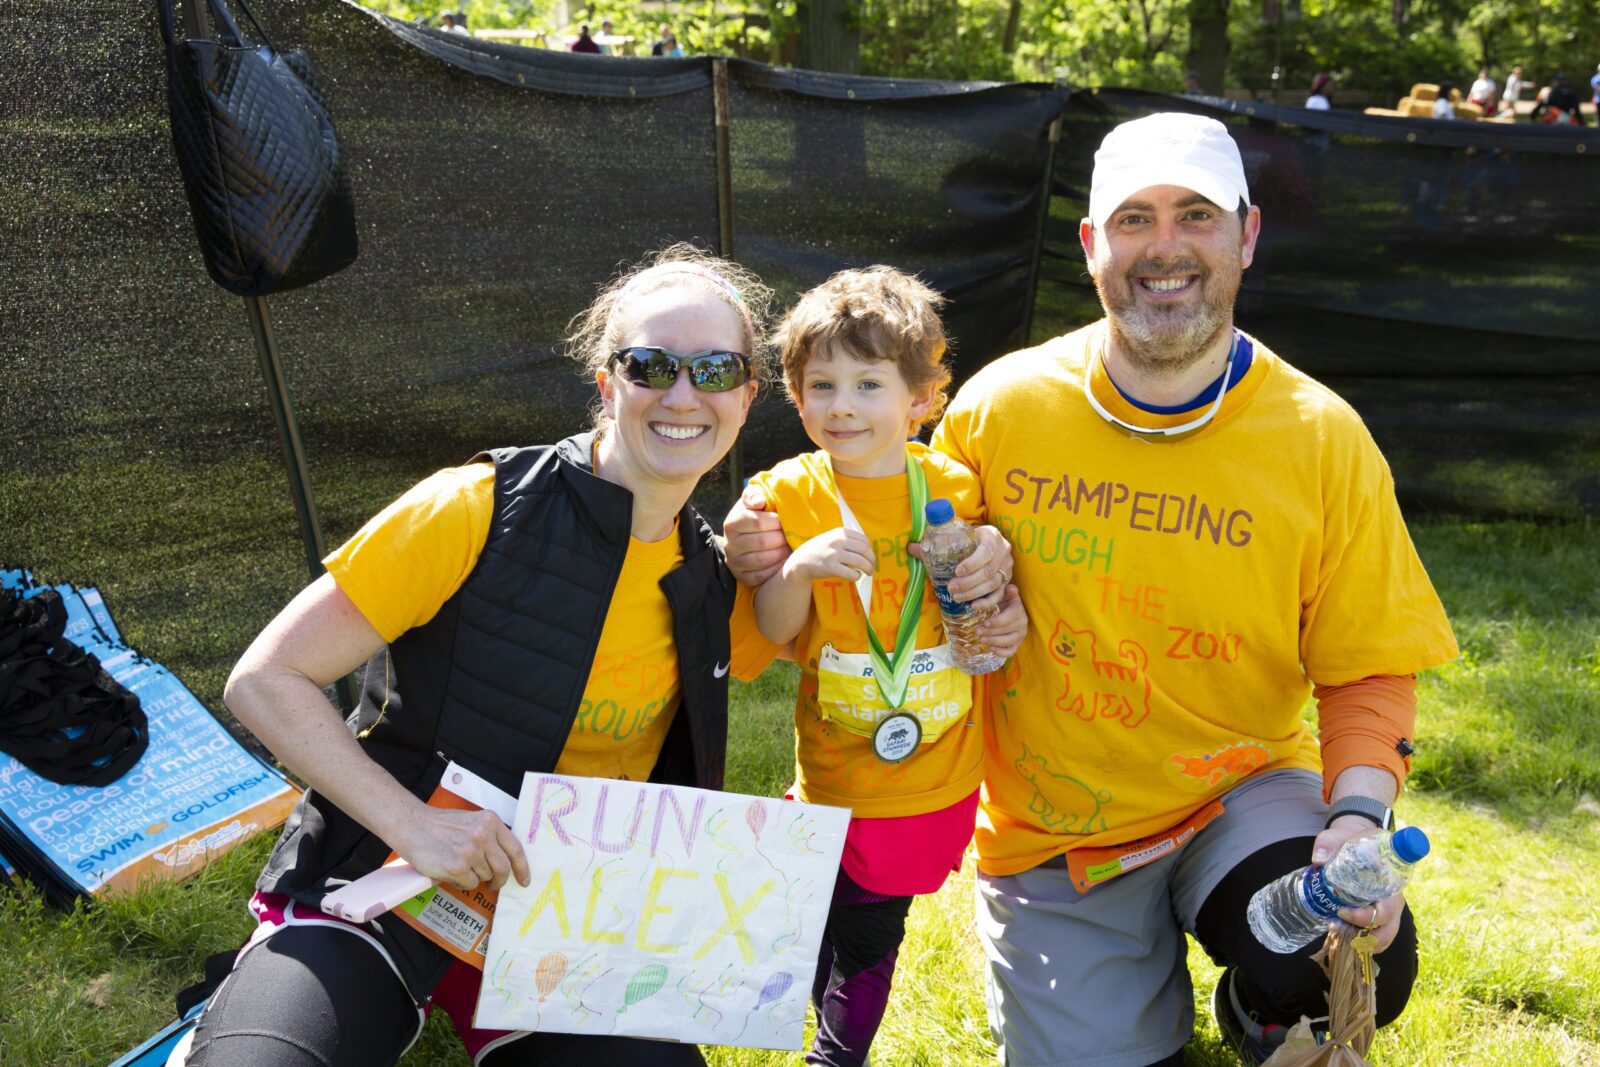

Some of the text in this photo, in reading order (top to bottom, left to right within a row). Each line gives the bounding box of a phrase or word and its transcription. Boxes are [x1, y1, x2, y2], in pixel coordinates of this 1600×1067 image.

[1003, 468, 1254, 547] STAMPEDING
[1095, 576, 1168, 624] THE
[1165, 626, 1243, 663] ZOO
[151, 748, 240, 789] backstroke
[883, 741, 912, 753] STAMPEDE
[29, 732, 231, 835] peace of mind
[52, 796, 162, 853] breaststroke
[161, 756, 252, 799] FREESTYLE
[67, 852, 81, 863] A
[80, 814, 151, 853] GOLDEN
[76, 832, 145, 873] SWIM
[171, 772, 270, 822] GOLDFISH
[527, 777, 706, 858] RUN
[1121, 840, 1171, 862] MATTHEW
[426, 905, 443, 919] June
[457, 926, 475, 940] 2019
[432, 894, 484, 933] ELIZABETH
[518, 866, 776, 965] ALEX
